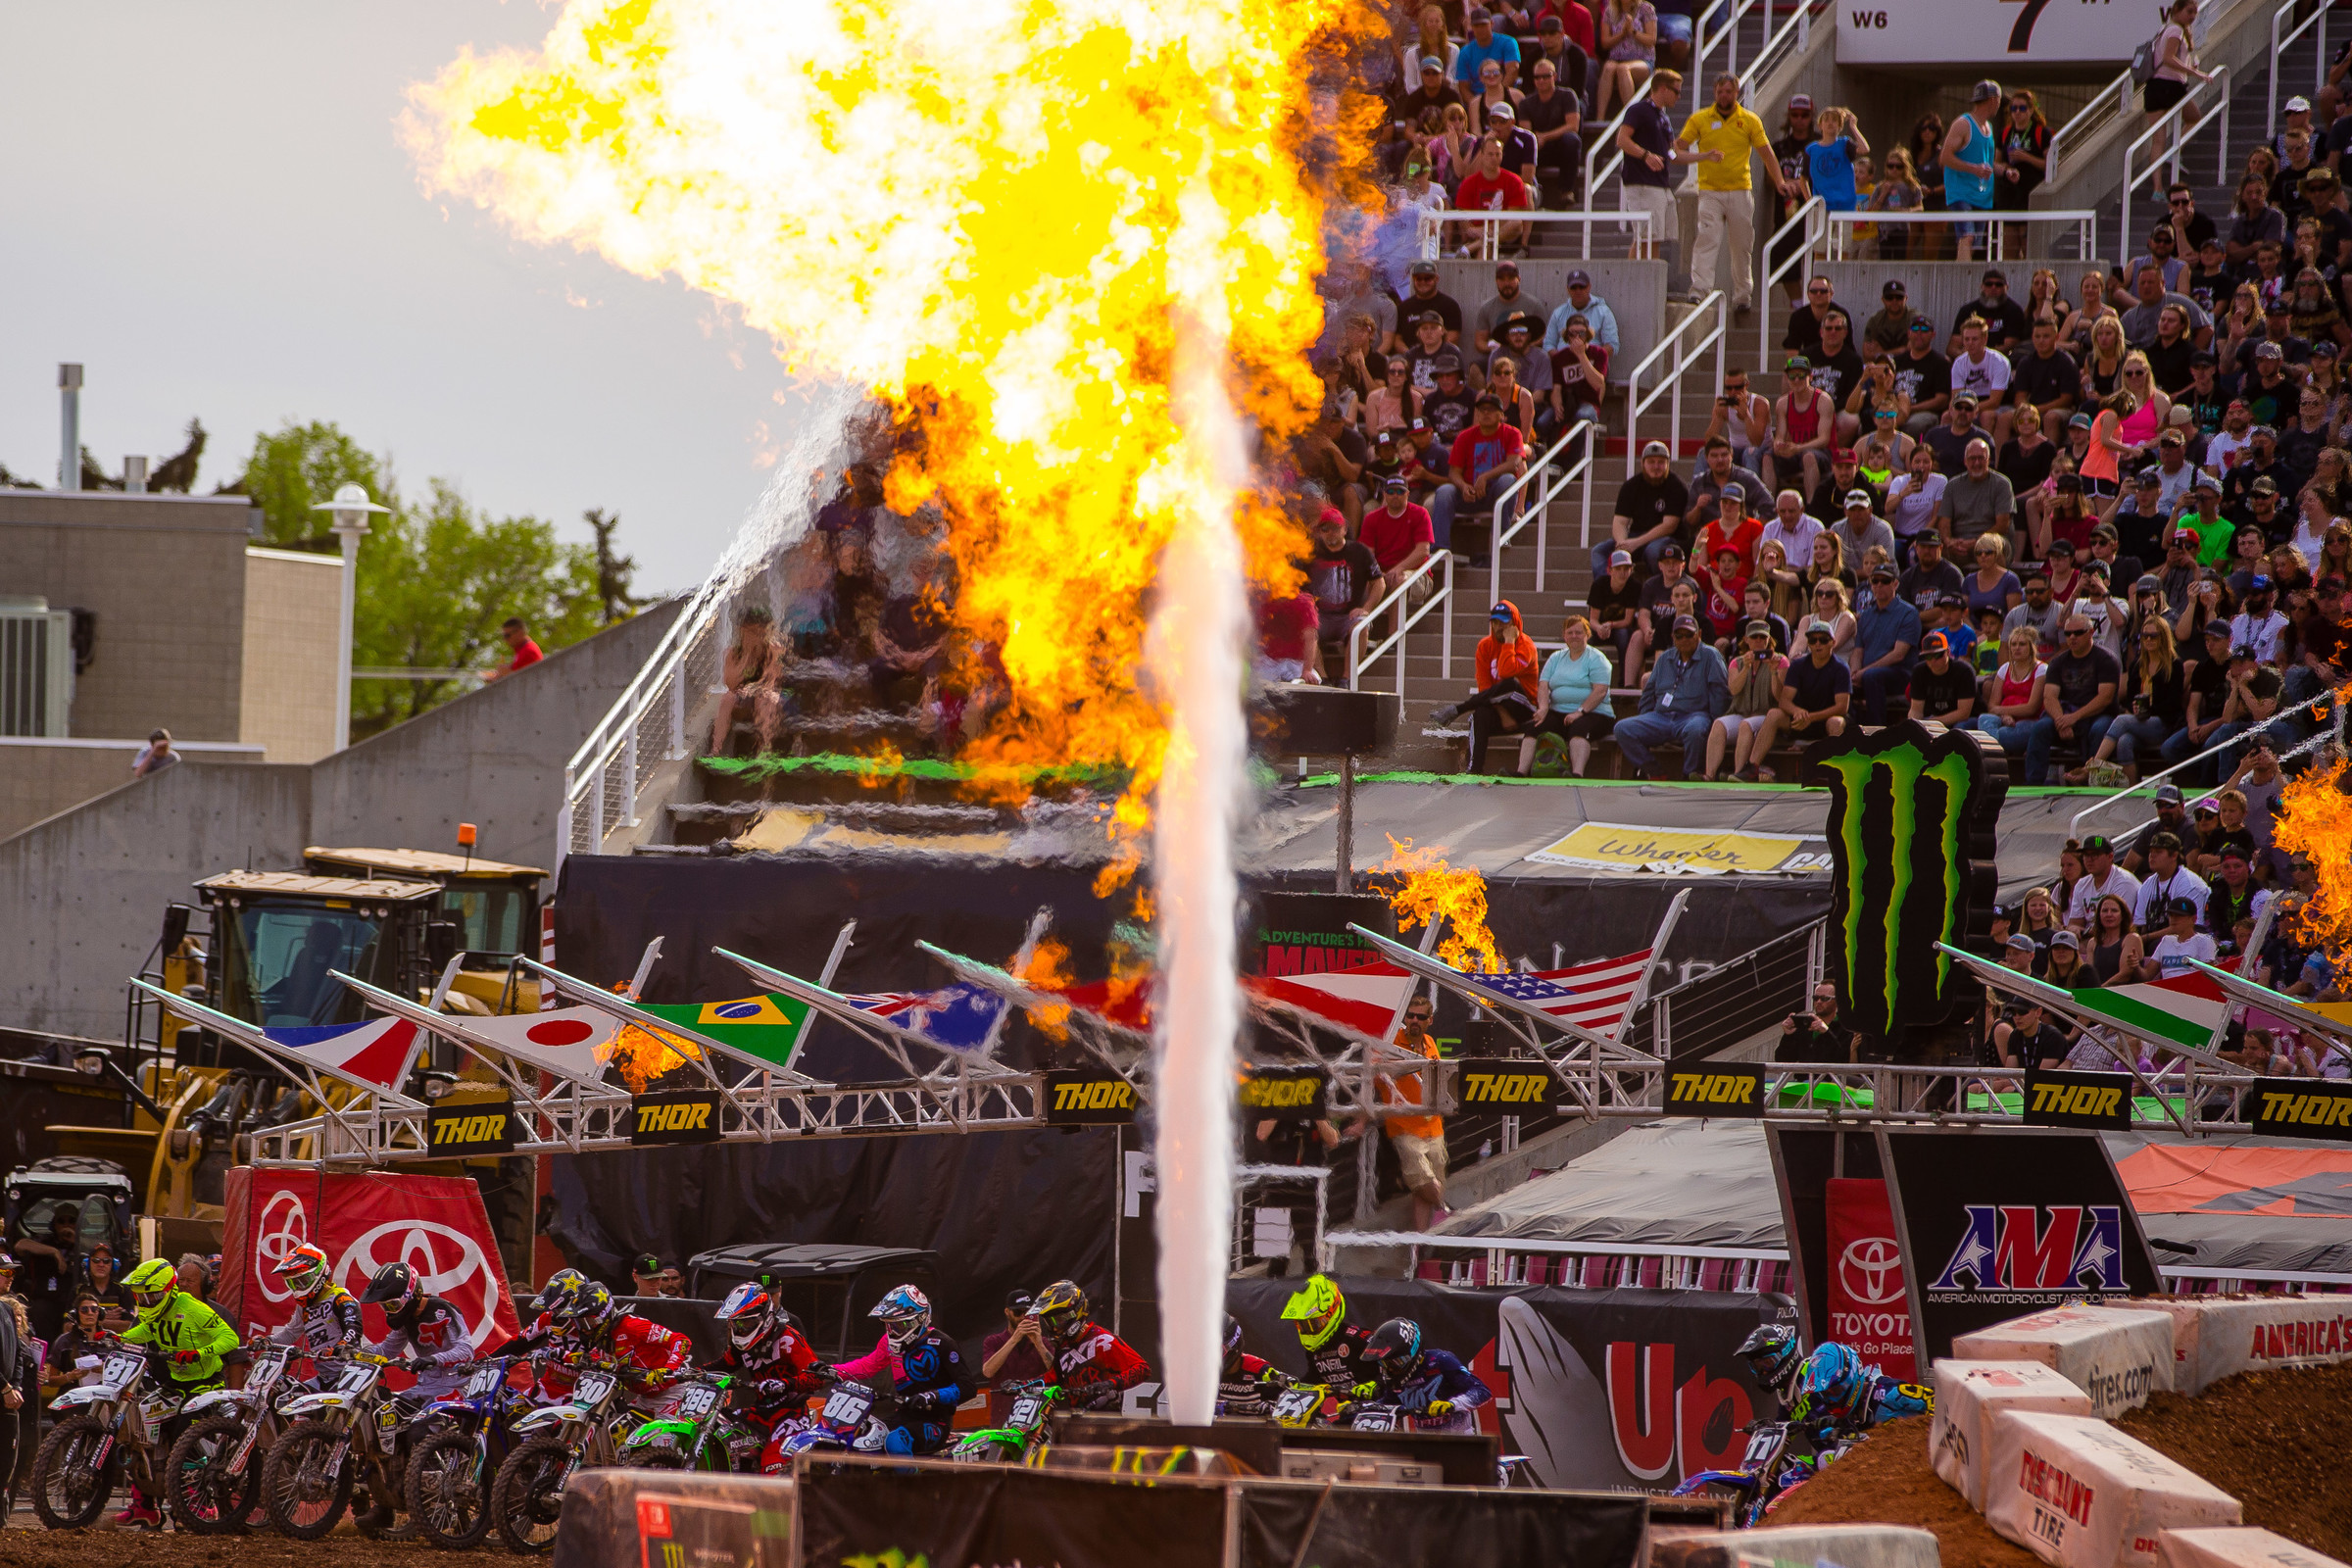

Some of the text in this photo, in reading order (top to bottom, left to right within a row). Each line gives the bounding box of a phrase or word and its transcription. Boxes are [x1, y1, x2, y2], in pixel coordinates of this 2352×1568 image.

[1851, 11, 1888, 29] W6
[1054, 1081, 1138, 1110] THOR
[1465, 1073, 1548, 1102] THOR
[1671, 1073, 1756, 1103] THOR
[2032, 1083, 2123, 1116] THOR
[638, 1102, 711, 1132] THOR
[2262, 1092, 2352, 1127] THOR
[434, 1114, 506, 1145] THOR
[1927, 1203, 2131, 1290] AMA
[1927, 1293, 1982, 1304] AMERICAN
[1983, 1294, 2063, 1304] MOTORCYCLIST
[149, 1320, 183, 1348] FLY
[1833, 1312, 1912, 1337] TOYOT
[1864, 1342, 1879, 1354] Go
[104, 1357, 139, 1386] 81
[337, 1364, 372, 1393] 71
[575, 1375, 607, 1404] 30
[681, 1388, 716, 1413] 388
[822, 1392, 870, 1424] 86
[1273, 1393, 1315, 1419] 54
[557, 1457, 575, 1492] DUNLOP
[2019, 1449, 2093, 1528] DISCOUNT
[2032, 1505, 2066, 1548] TIRE
